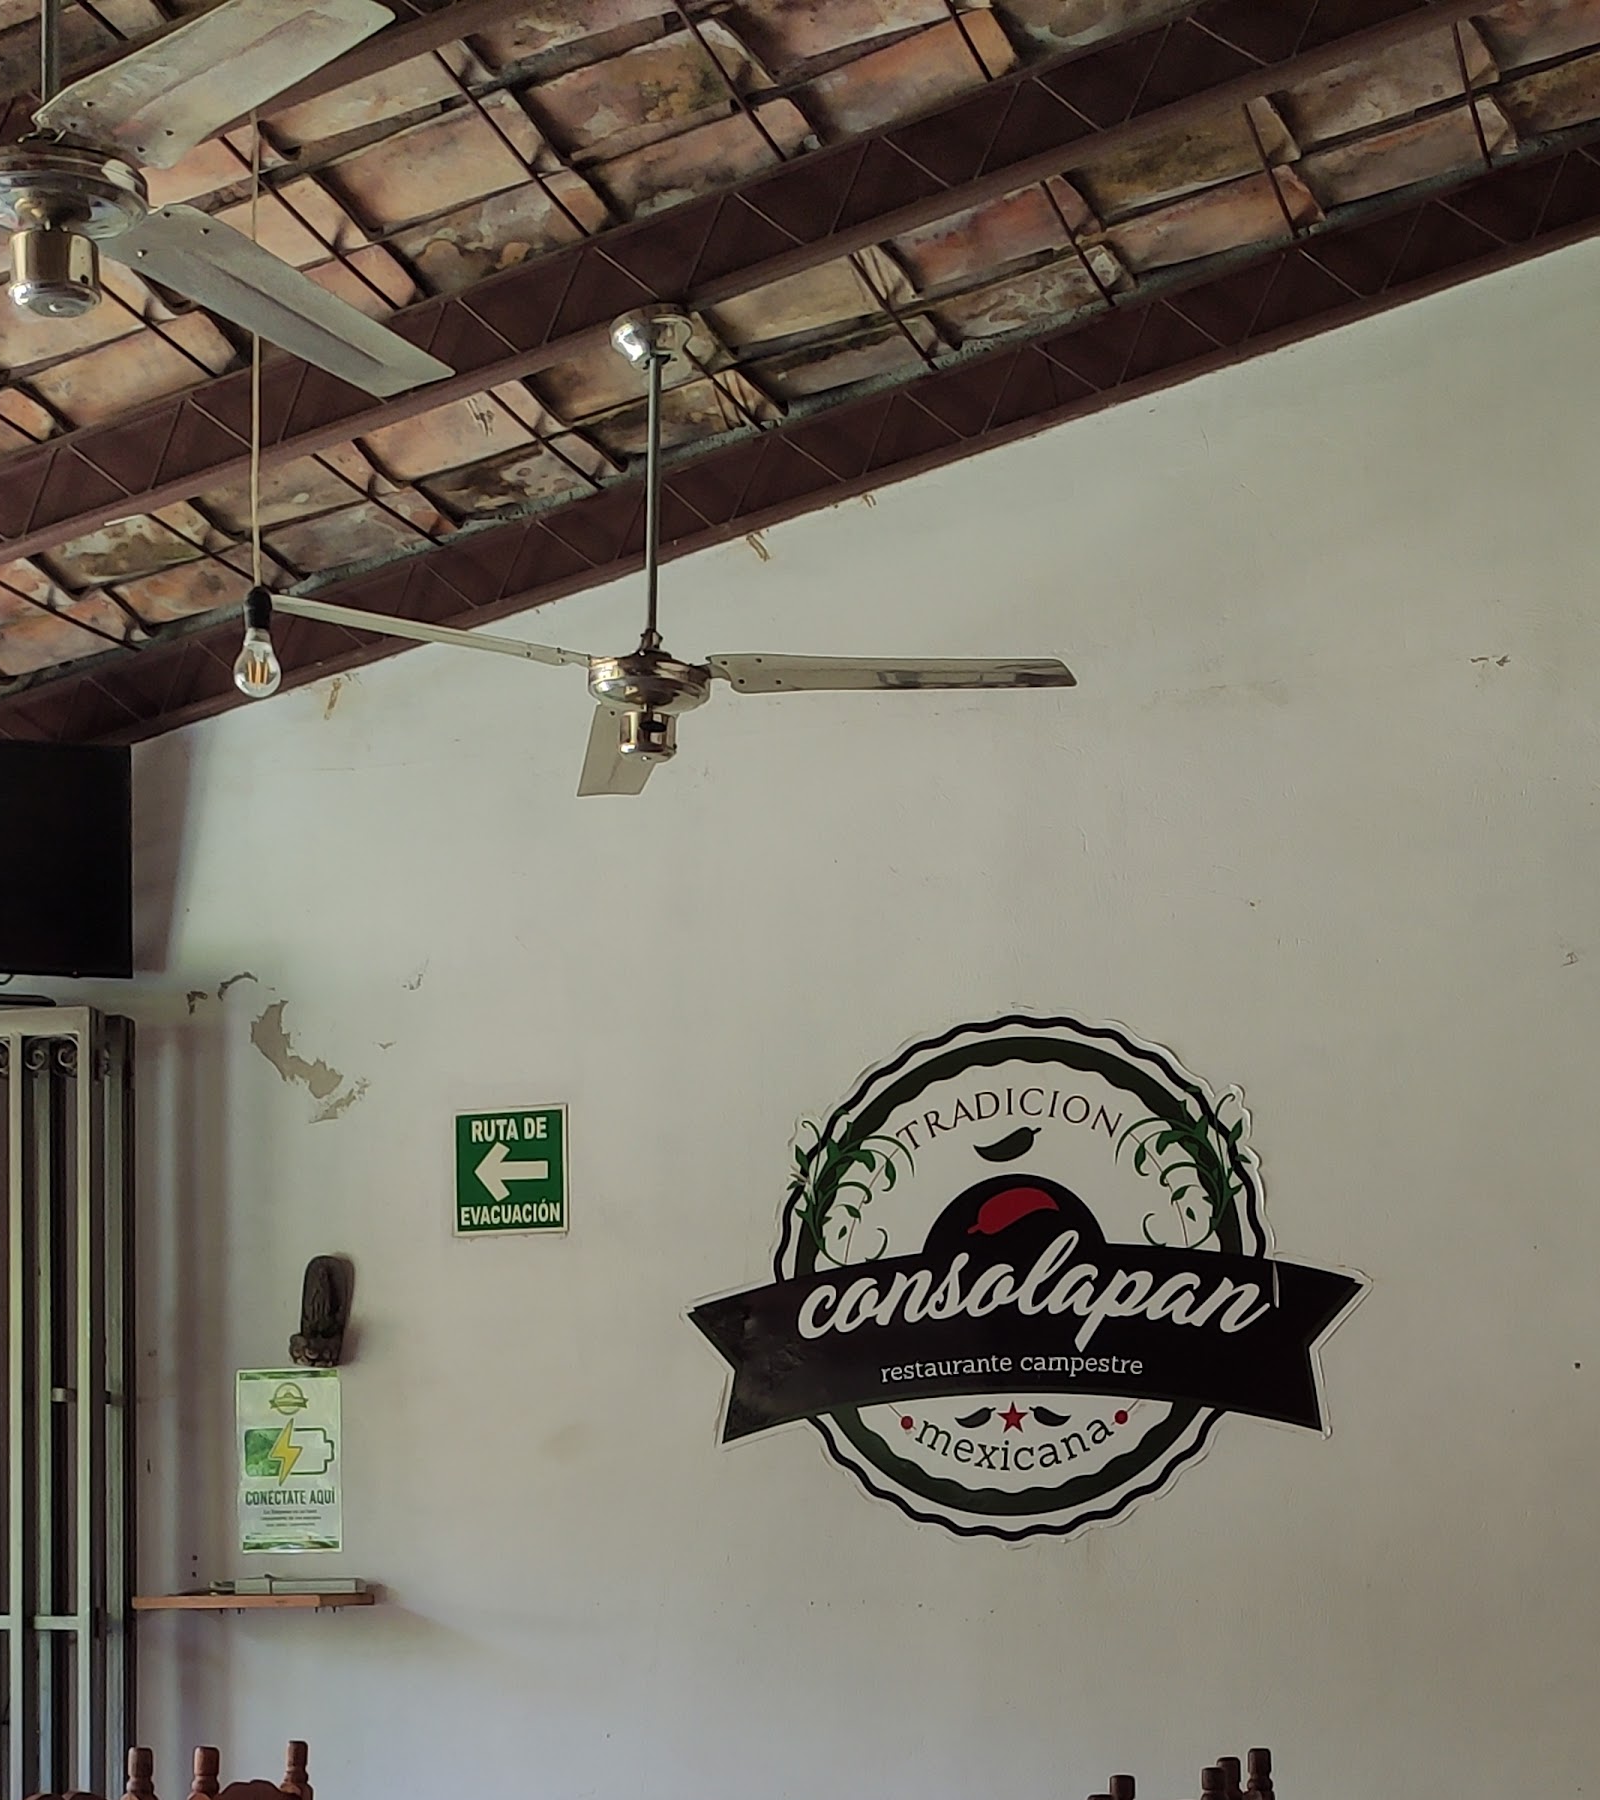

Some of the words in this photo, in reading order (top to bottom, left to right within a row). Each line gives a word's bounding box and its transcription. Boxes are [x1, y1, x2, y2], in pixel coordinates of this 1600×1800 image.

[471, 1118, 519, 1143] RUTA
[523, 1116, 547, 1140] DE
[896, 1087, 1123, 1150] TRADICION
[460, 1198, 561, 1226] EVACUACIÓN
[798, 1230, 1271, 1353] consolapan
[880, 1355, 1013, 1383] restaurante
[1020, 1355, 1144, 1377] campestre
[914, 1417, 1115, 1471] mexicana
[309, 1486, 336, 1506] AQUÍ
